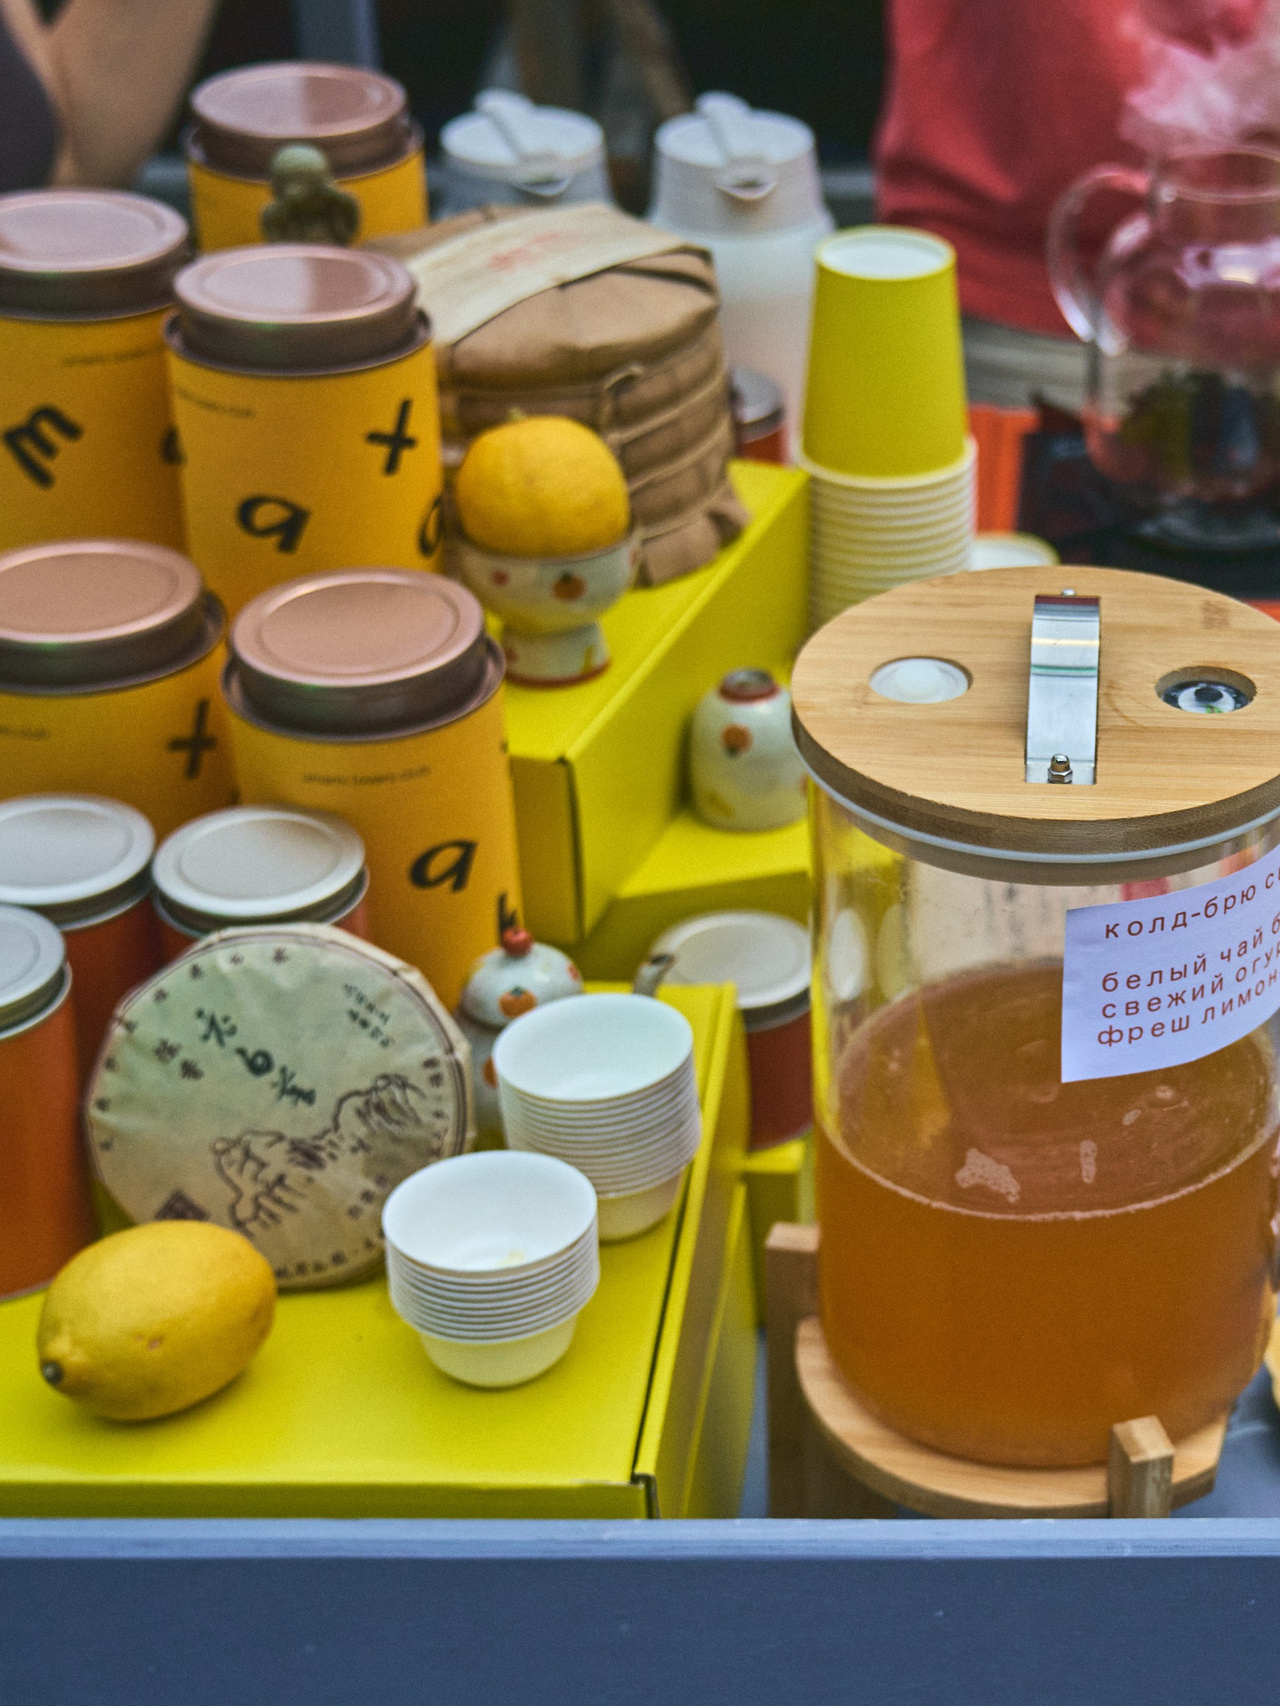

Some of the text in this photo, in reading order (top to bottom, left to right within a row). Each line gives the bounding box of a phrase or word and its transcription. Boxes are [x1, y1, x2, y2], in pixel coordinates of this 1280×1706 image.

[1105, 884, 1256, 939] колд-брю
[1102, 954, 1207, 993] белый
[1220, 926, 1263, 963] чай
[1102, 973, 1224, 1019] свежий
[1097, 1014, 1190, 1047] фреш
